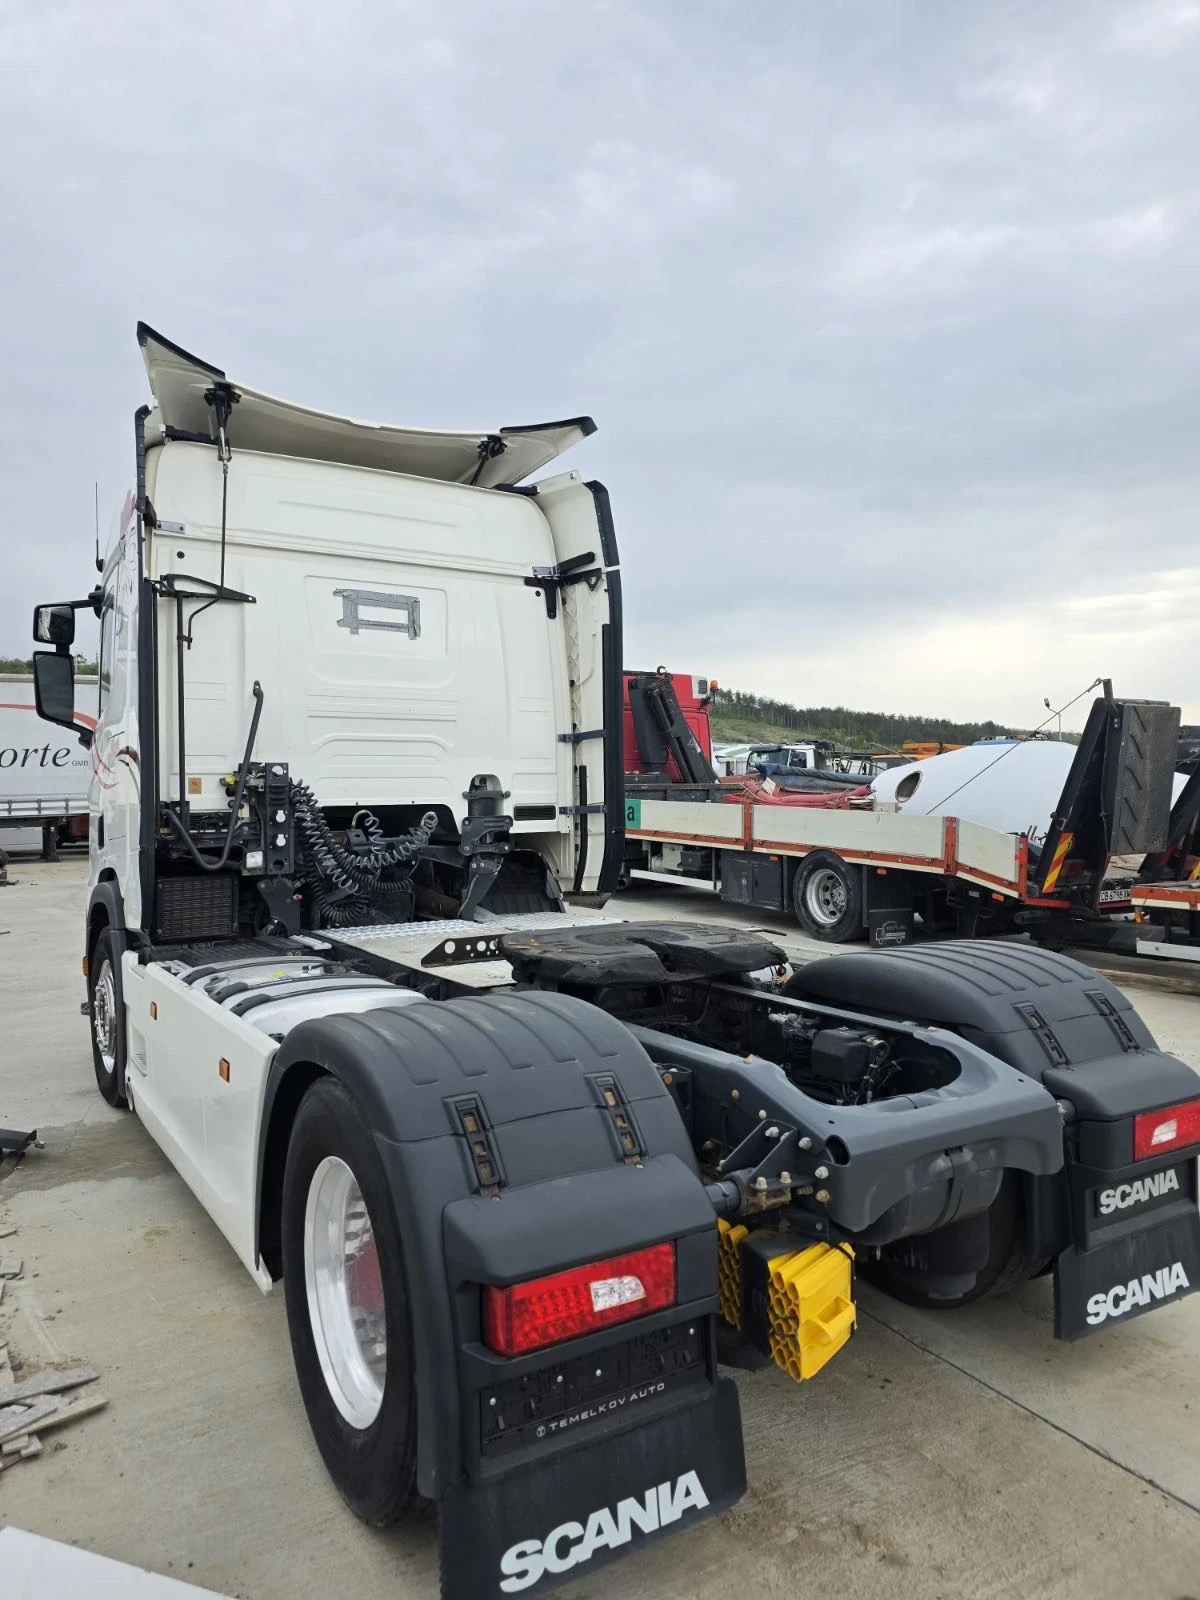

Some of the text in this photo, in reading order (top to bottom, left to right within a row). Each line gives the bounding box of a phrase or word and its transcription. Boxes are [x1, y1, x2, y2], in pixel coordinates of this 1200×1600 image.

[1099, 1168, 1180, 1215] SCANIA
[1086, 1261, 1190, 1326] SCANIA
[549, 1396, 627, 1431] TEMELKOV
[629, 1382, 665, 1402] AUTO
[499, 1470, 710, 1593] SCANIA
